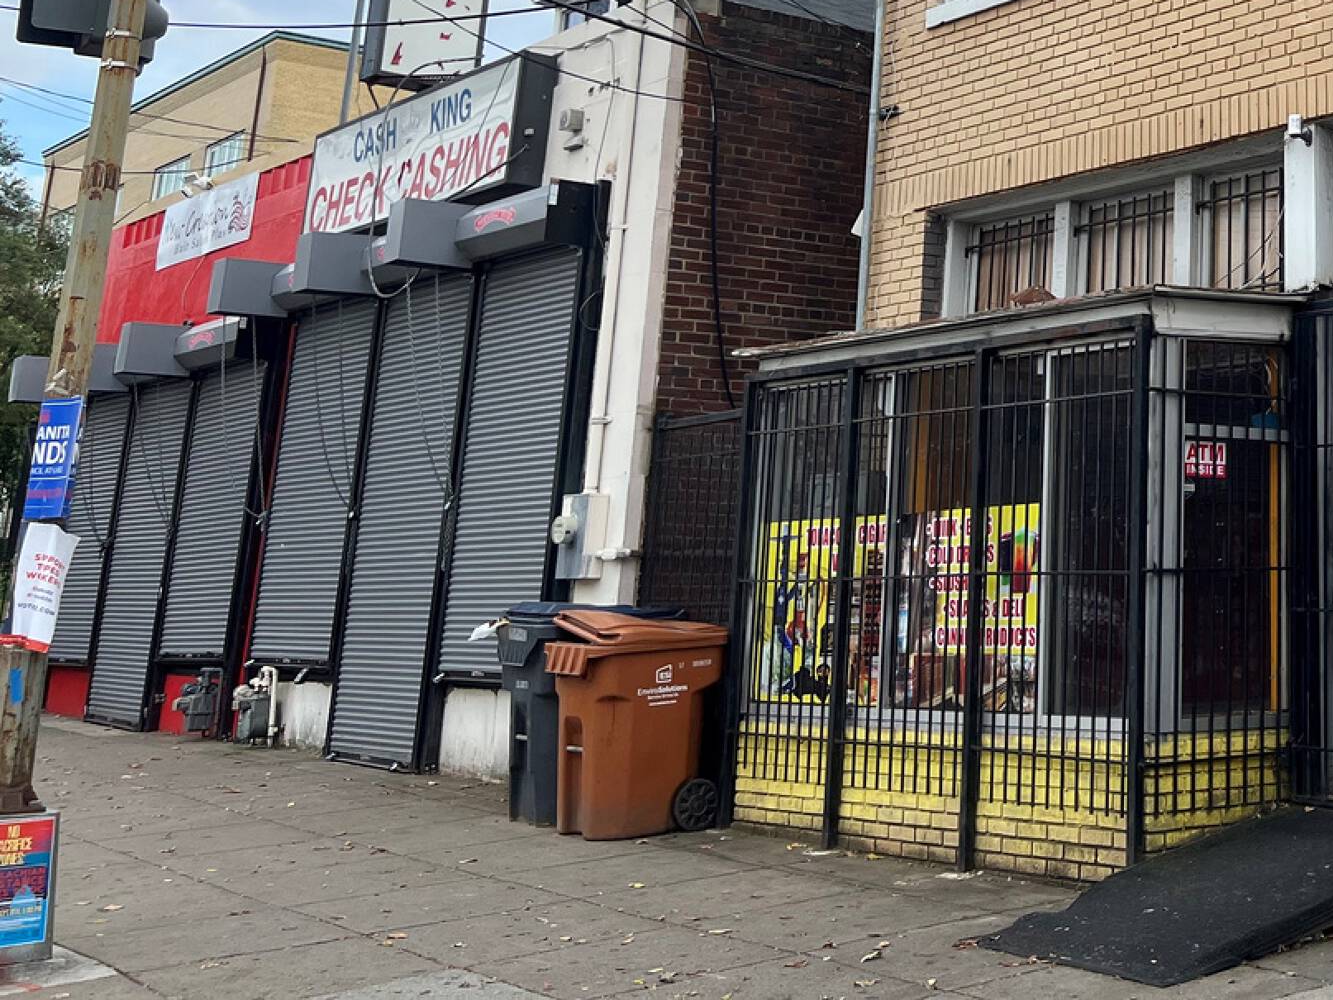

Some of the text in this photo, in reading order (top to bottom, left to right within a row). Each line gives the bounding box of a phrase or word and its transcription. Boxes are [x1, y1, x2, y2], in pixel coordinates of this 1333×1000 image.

[354, 88, 472, 163] CASH KING
[310, 121, 511, 233] CHECK CASHING
